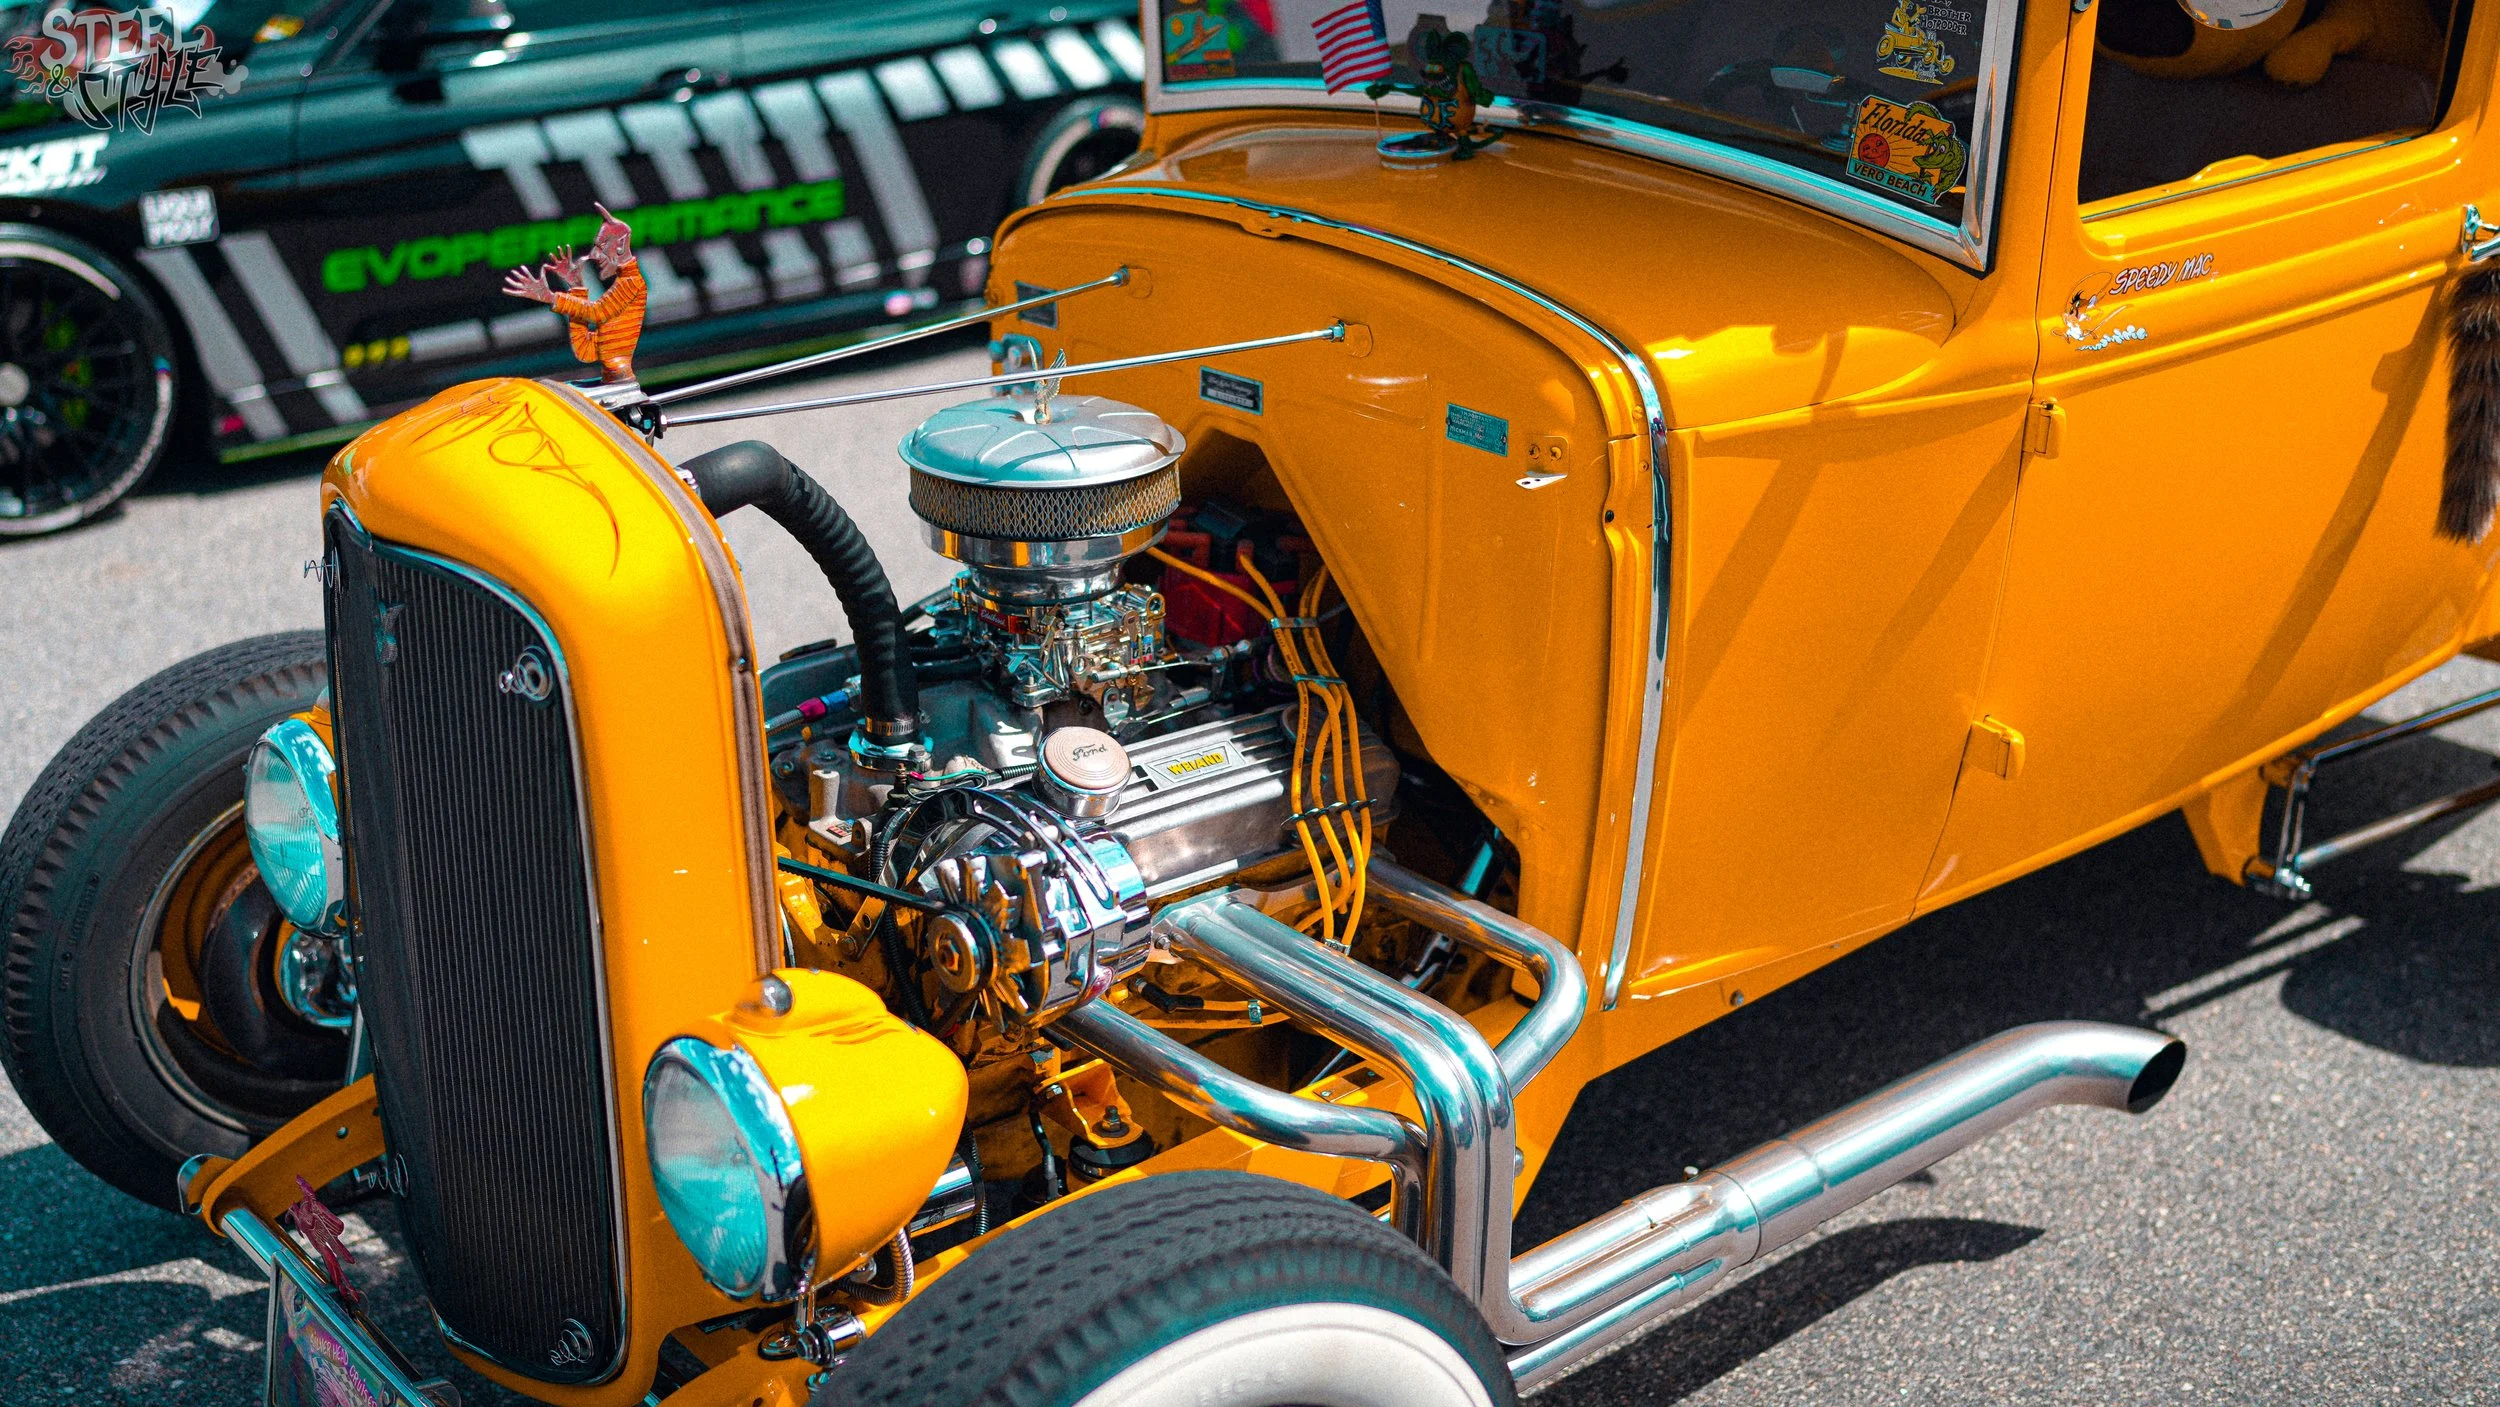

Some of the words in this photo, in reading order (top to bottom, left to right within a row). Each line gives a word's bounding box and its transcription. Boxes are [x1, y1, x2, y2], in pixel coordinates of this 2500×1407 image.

[1920, 14, 1967, 36] HOTRODDER
[1928, 5, 1972, 23] BROTHER
[1860, 102, 1929, 144] Florida
[1854, 163, 1885, 182] VERO
[1887, 174, 1928, 197] BEACH
[2109, 261, 2179, 296] SPEEDY
[2175, 252, 2214, 283] MAC
[1072, 743, 1108, 762] Ford
[1167, 751, 1224, 775] WEIAND
